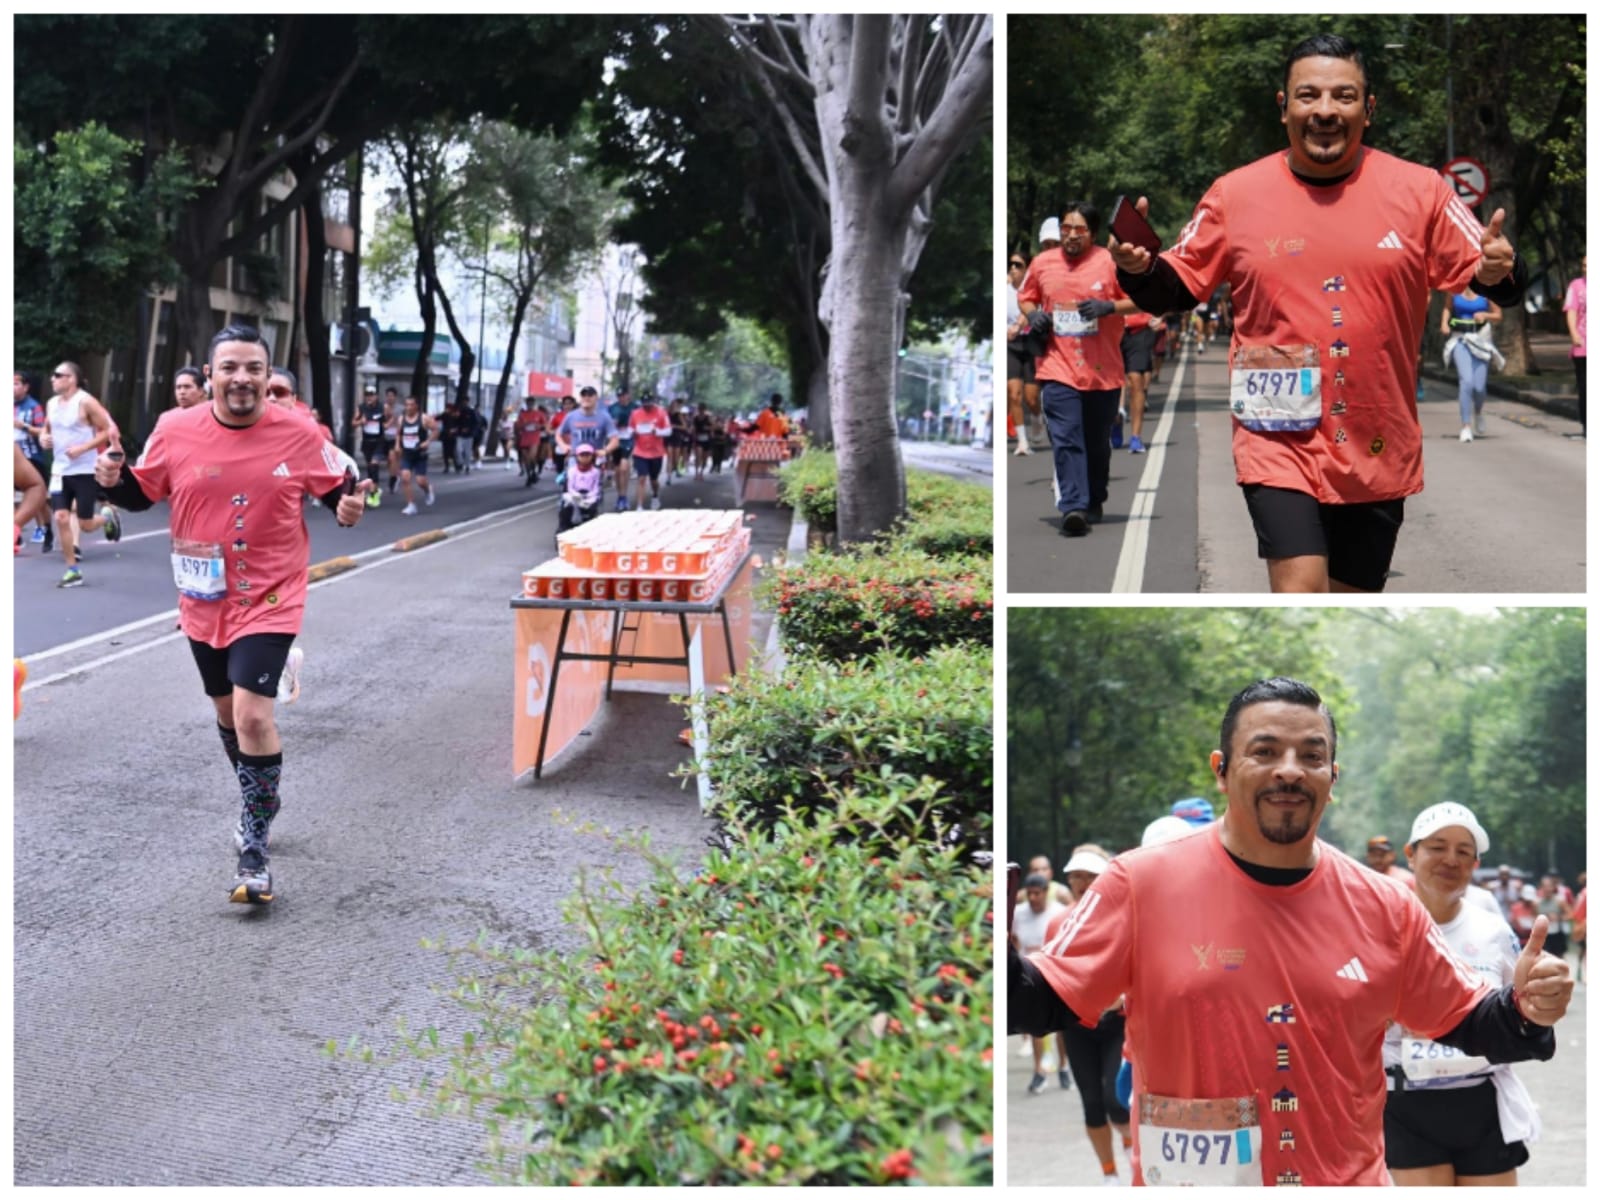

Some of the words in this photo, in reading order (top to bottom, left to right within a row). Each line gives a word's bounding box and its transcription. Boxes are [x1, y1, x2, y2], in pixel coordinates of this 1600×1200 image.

[1058, 312, 1080, 322] 226
[1247, 372, 1298, 396] 6797
[617, 555, 632, 571] G
[662, 555, 677, 572] G
[524, 577, 538, 594] G
[550, 578, 564, 594] G
[591, 579, 606, 596] G
[616, 580, 630, 596] G
[638, 580, 653, 597] G
[664, 580, 678, 597] G
[690, 581, 705, 598] G
[1411, 1041, 1462, 1059] 268
[1162, 1131, 1231, 1165] 6797
